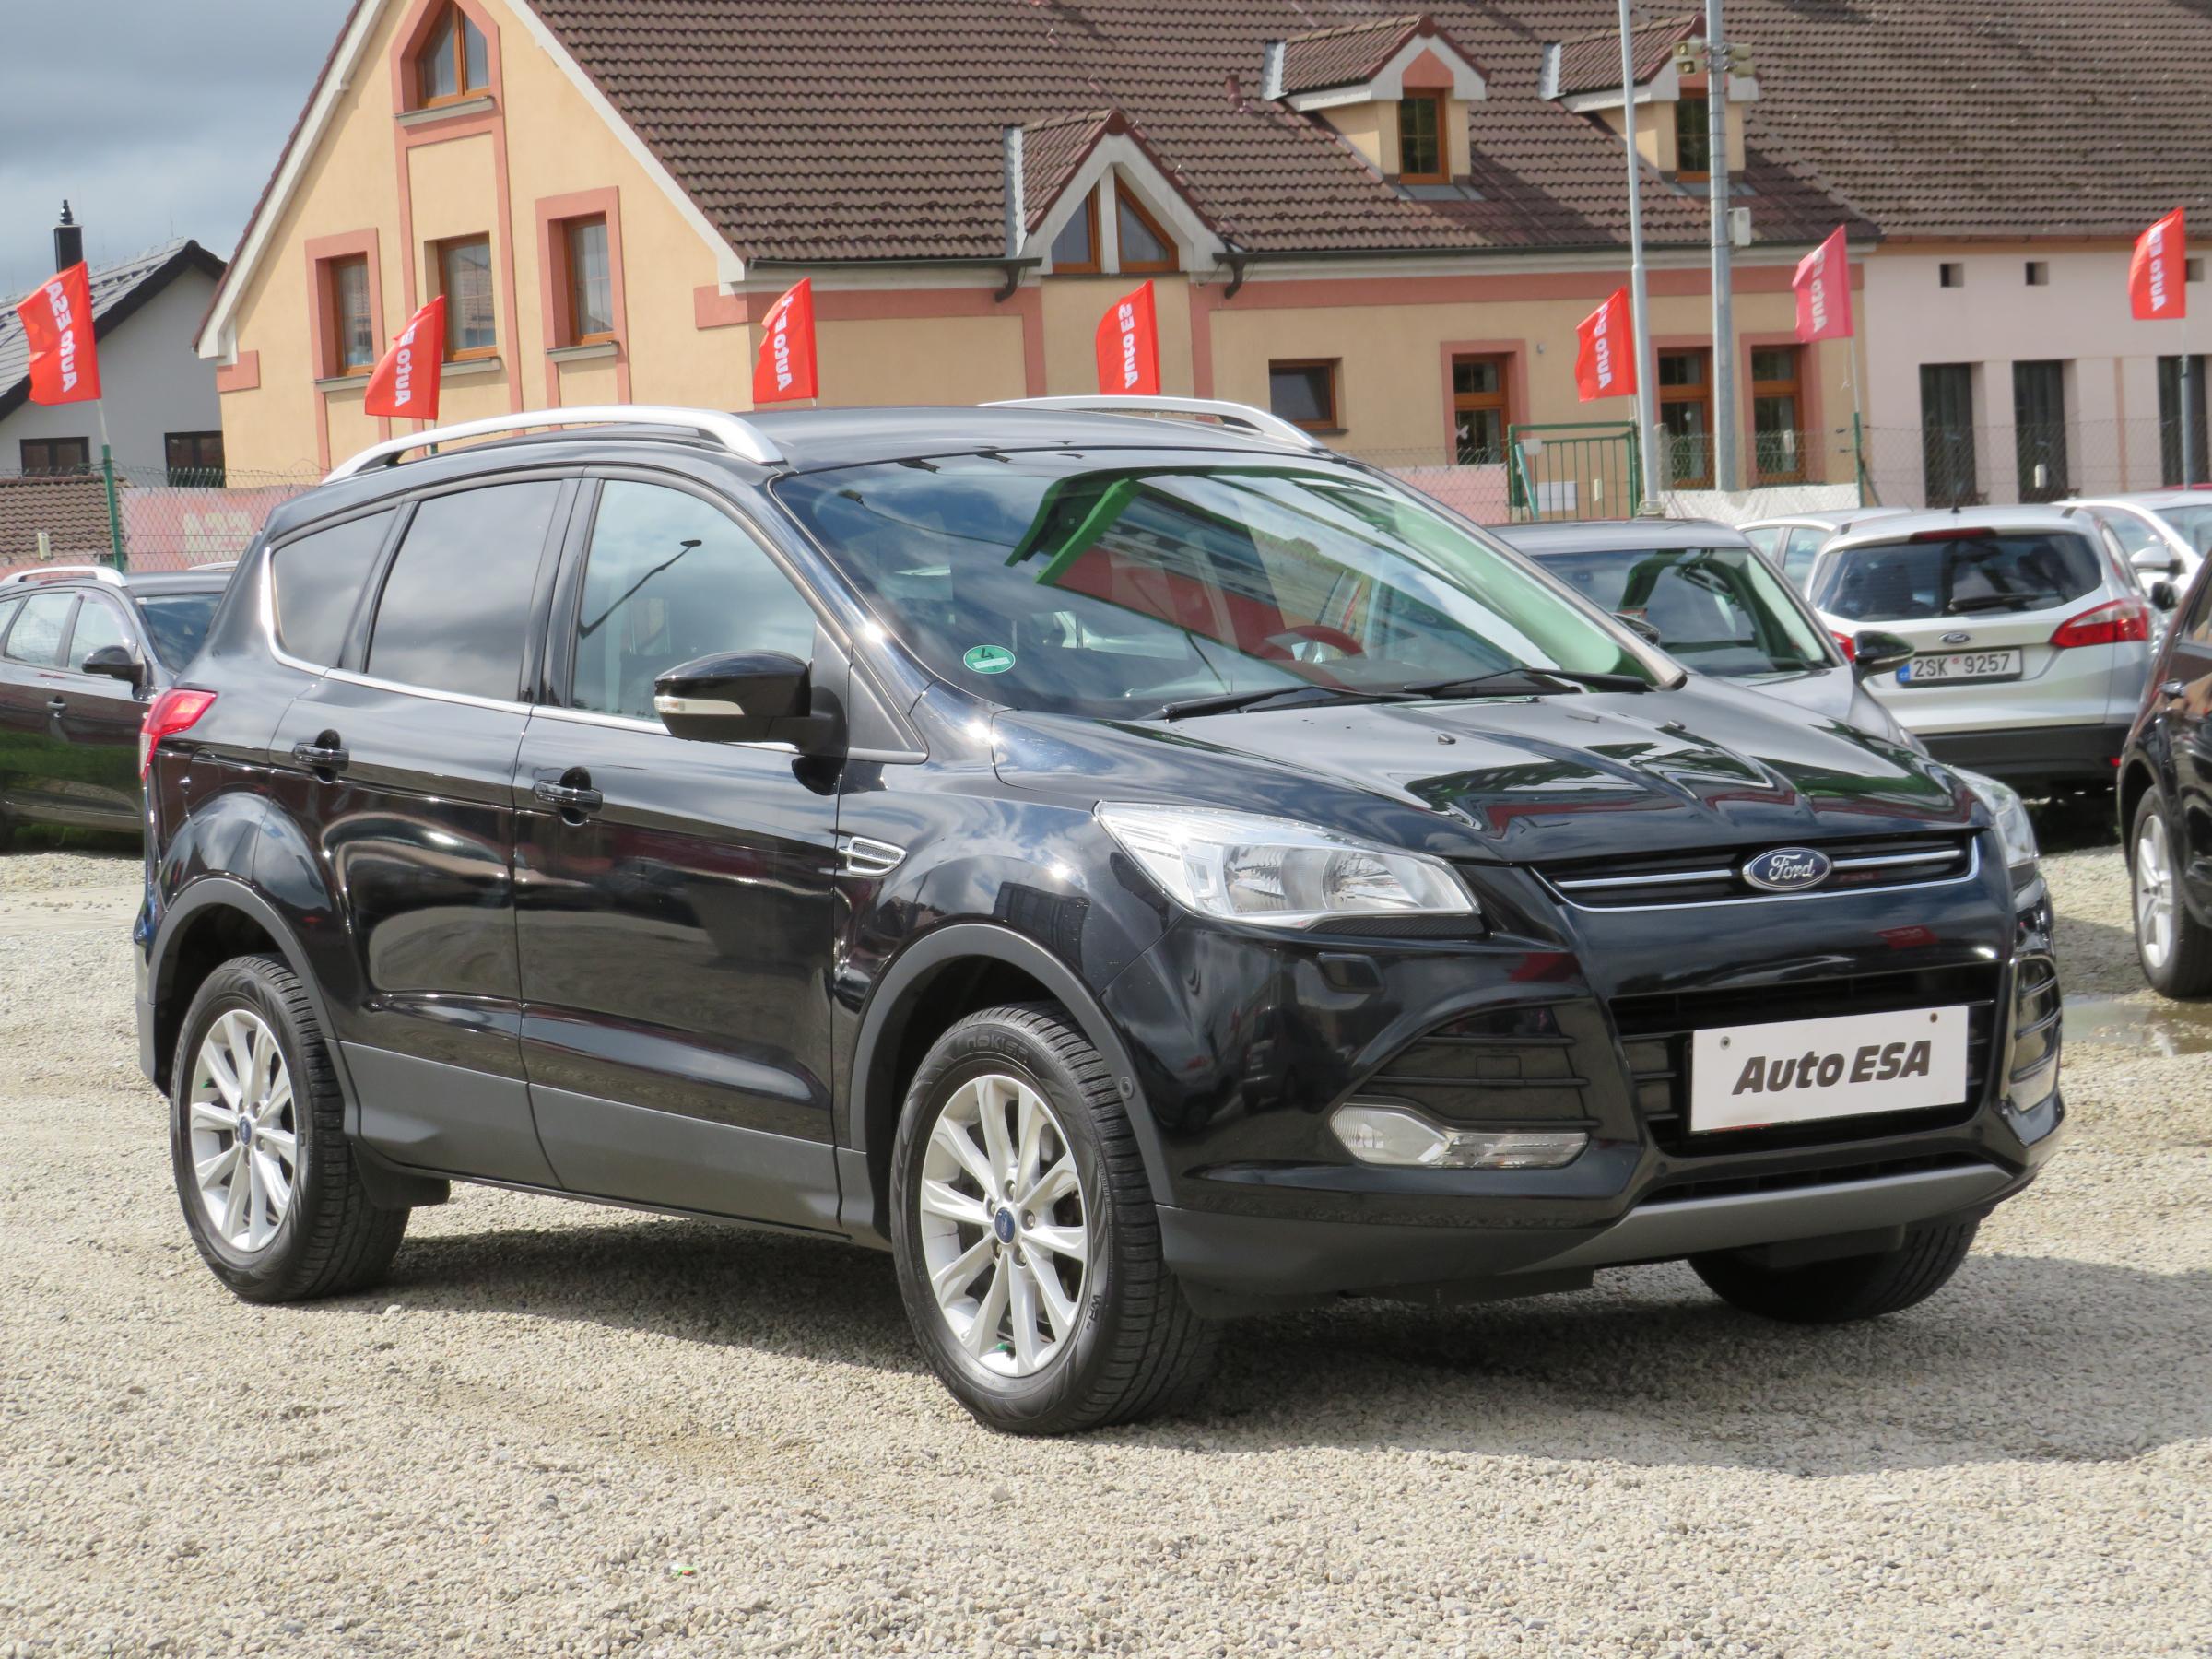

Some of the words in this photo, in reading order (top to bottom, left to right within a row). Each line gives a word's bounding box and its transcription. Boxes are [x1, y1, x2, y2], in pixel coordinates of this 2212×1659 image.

[1913, 658, 1948, 678] 2SK
[1964, 653, 2011, 674] 9257
[1769, 854, 1816, 881] Ford
[1732, 1051, 1845, 1095] Auto
[1849, 1040, 1932, 1084] ESA
